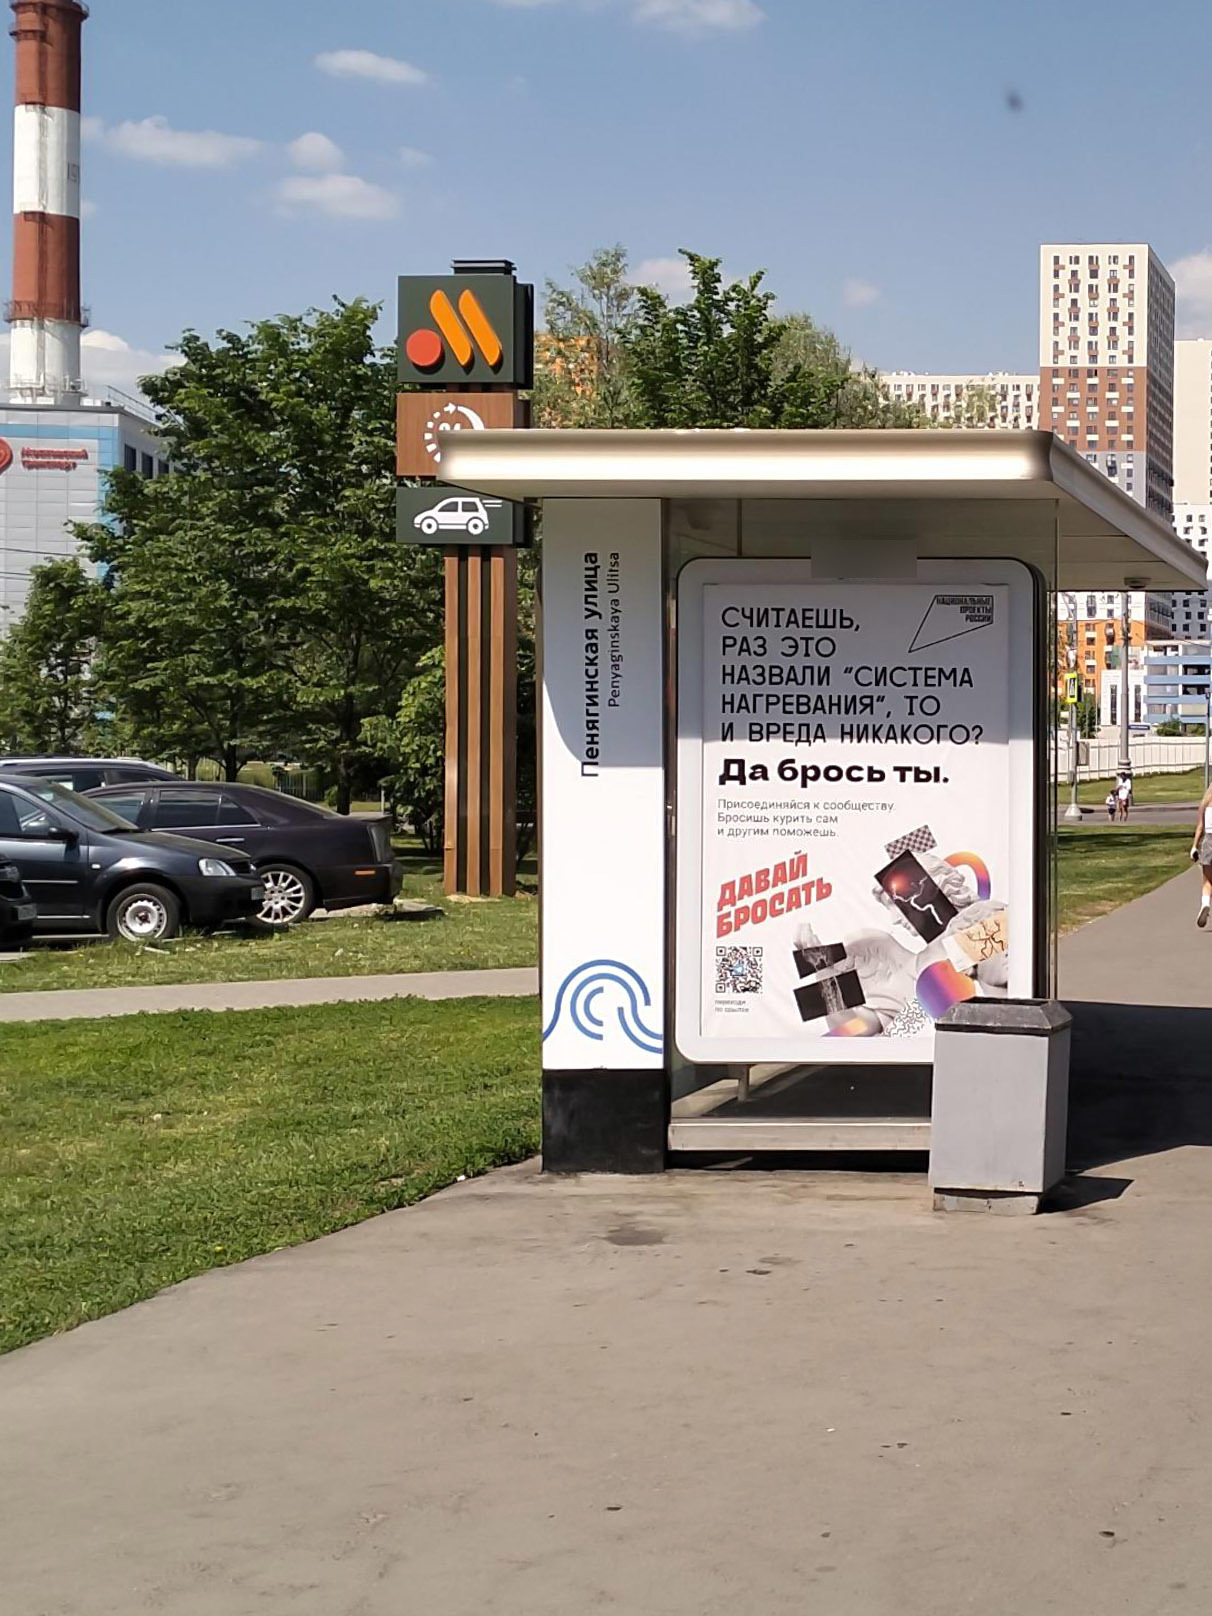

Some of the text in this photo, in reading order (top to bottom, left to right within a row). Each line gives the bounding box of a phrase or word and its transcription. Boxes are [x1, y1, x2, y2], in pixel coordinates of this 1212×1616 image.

[607, 552, 623, 707] Penyaginskaya Ulitsa
[721, 607, 861, 633] СЧИТАЕШЬ,
[722, 636, 836, 658] РАЗ ЭТО
[581, 552, 602, 777] Пенягинская улица
[721, 665, 831, 687] НАЗВАЛИ
[904, 695, 941, 716] ТО
[721, 722, 984, 747] И ВРЕДА НИКАКОГО?
[718, 758, 949, 789] Да брось ты.
[718, 798, 811, 811] Присоединяйся
[813, 801, 821, 810] к
[717, 812, 839, 825] Бросишь курить сам
[717, 827, 725, 836] и
[727, 828, 769, 839] другим
[717, 849, 808, 912] ДАВАЙ
[716, 877, 832, 939] БРОСАТЬ
